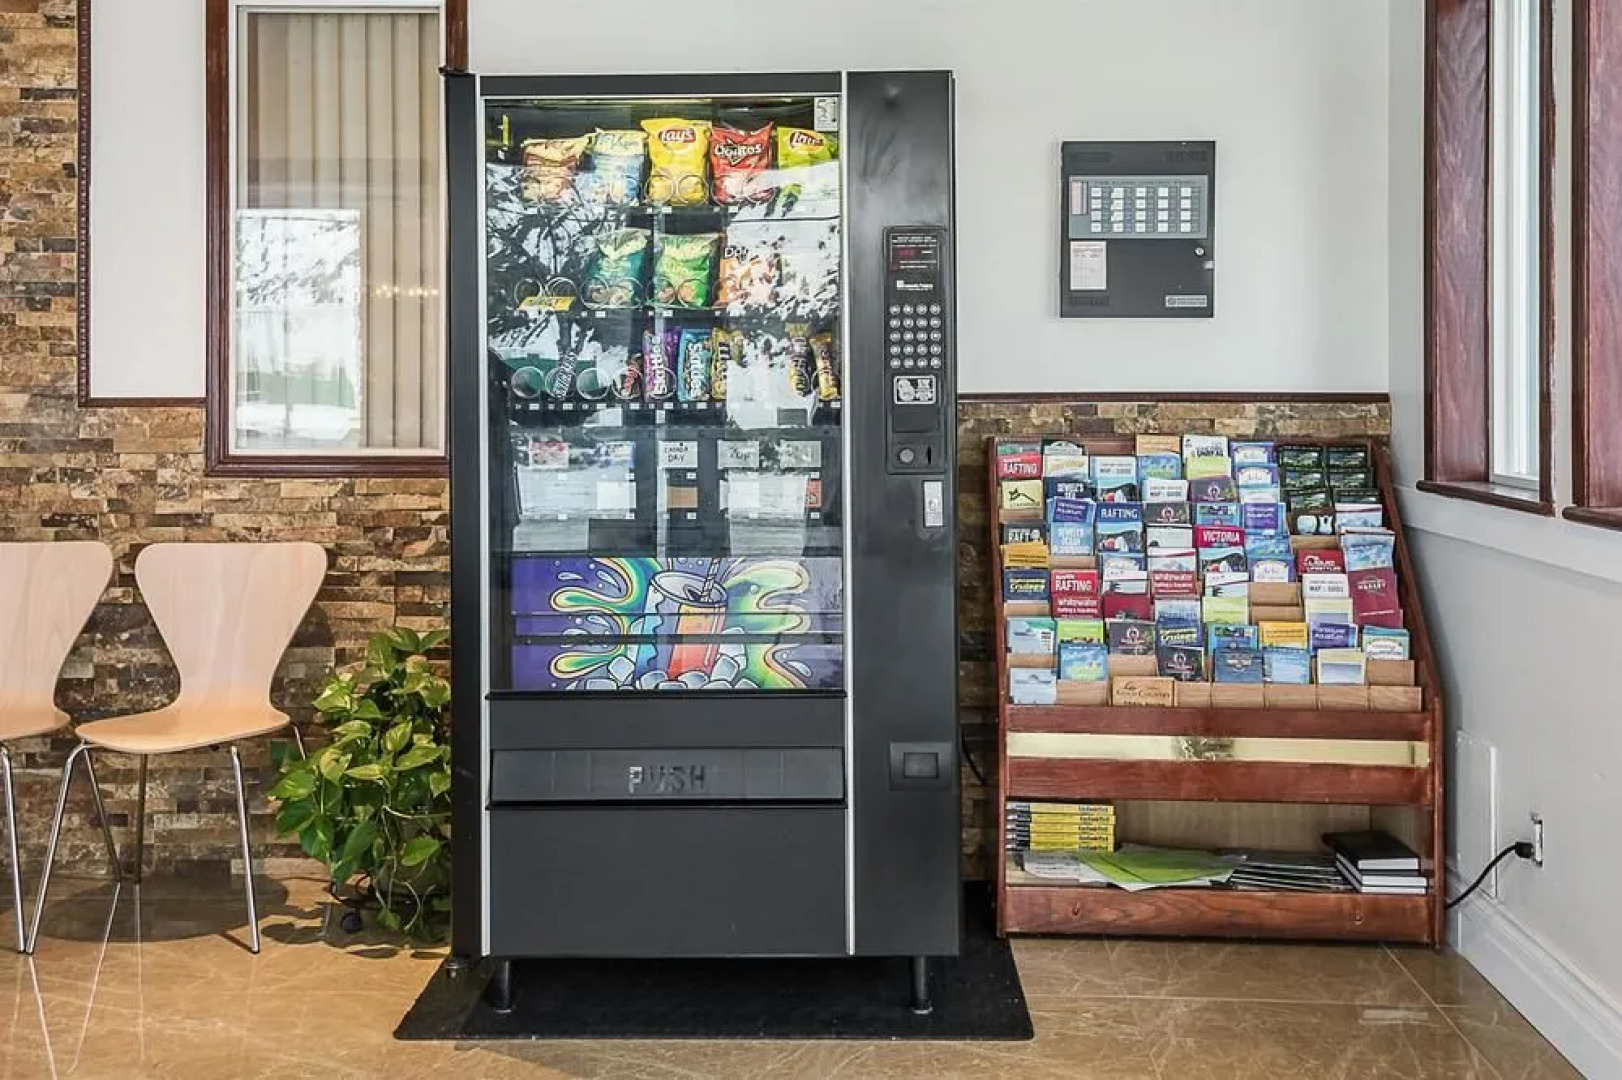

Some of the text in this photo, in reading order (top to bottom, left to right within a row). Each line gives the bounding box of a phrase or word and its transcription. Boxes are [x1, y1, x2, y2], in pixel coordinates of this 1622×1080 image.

[713, 142, 763, 158] Doritos
[1003, 463, 1038, 475] RAFTING
[1100, 508, 1138, 519] RAFTING
[1202, 531, 1240, 543] VICTORIA
[1055, 579, 1093, 591] RAFTING
[628, 765, 706, 794] PUSH
